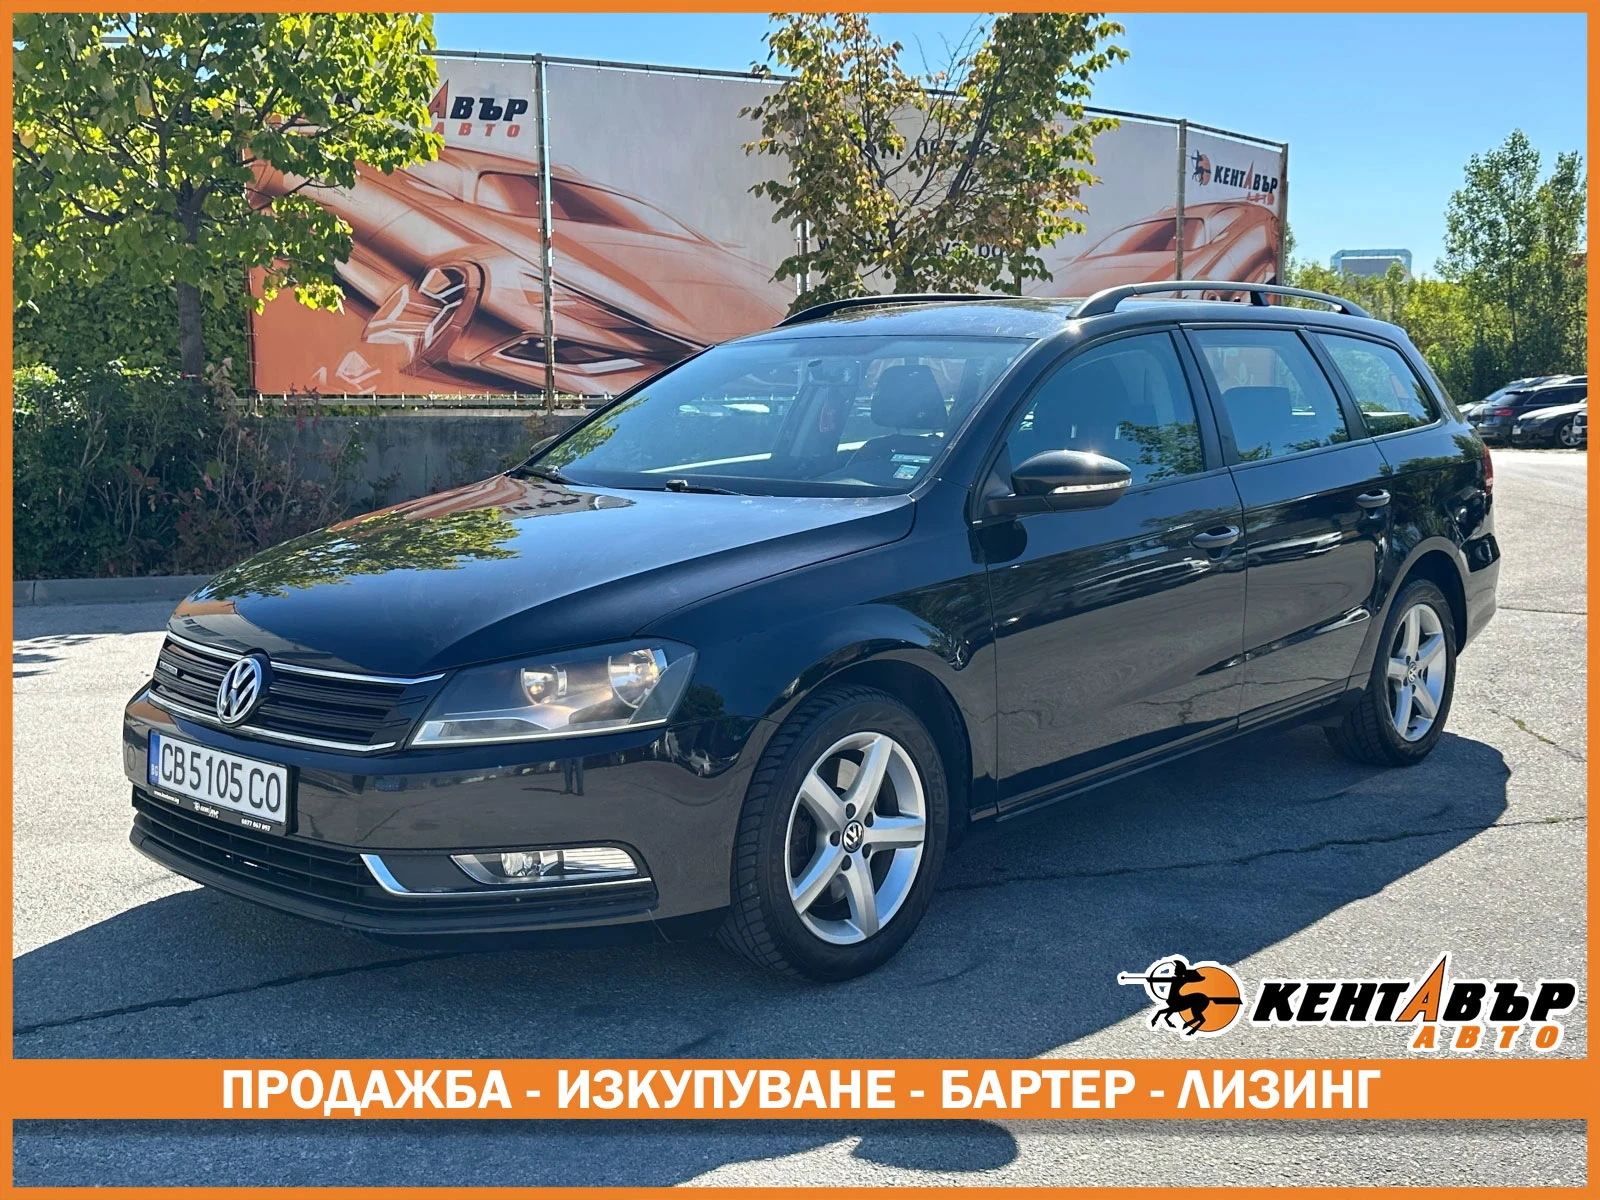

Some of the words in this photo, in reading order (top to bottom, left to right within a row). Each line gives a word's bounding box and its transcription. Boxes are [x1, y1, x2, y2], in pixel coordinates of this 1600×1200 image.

[428, 79, 529, 121] АВЪР
[432, 121, 521, 137] АВТО
[1213, 160, 1279, 193] КЕНТАВЪР
